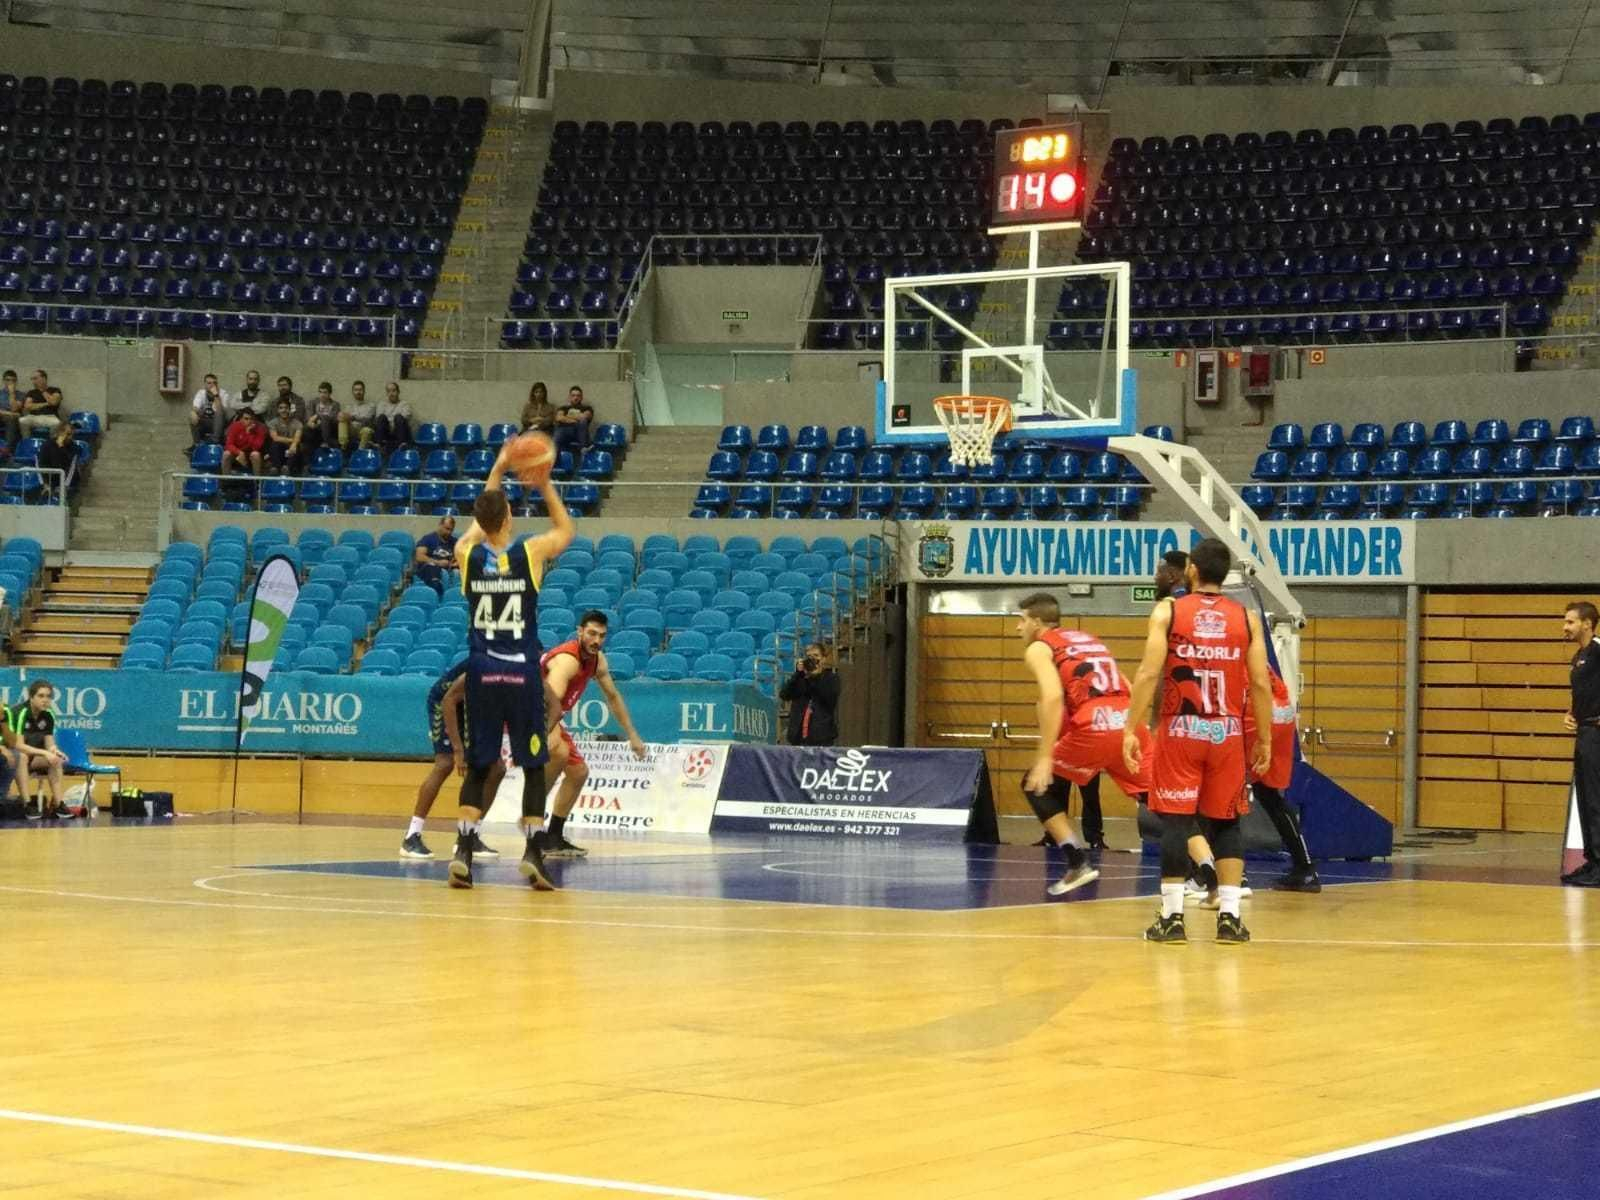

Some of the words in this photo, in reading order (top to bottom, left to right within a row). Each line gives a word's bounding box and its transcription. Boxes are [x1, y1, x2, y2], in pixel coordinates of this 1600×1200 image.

[1008, 172, 1046, 211] 14
[1241, 526, 1403, 577] NTANDER
[1135, 589, 1155, 600] SAL
[473, 593, 526, 640] 44
[1175, 643, 1241, 660] CAZORLA
[0, 686, 107, 718] IRIO
[178, 688, 228, 720] EL
[54, 714, 103, 730] NTAÑÉS
[678, 701, 727, 733] EL
[291, 722, 359, 735] MONTAÑÉS
[616, 754, 657, 764] SANRE
[587, 774, 651, 791] parte
[577, 793, 622, 811] IDA
[810, 793, 873, 802] ABOGADOS
[582, 813, 655, 828] sangre
[762, 805, 838, 818] ESPECIALISTAS
[840, 808, 855, 818] EN
[857, 808, 917, 821] HERENCIAS
[843, 824, 864, 835] 942
[864, 825, 881, 835] 377
[883, 825, 901, 836] 321
